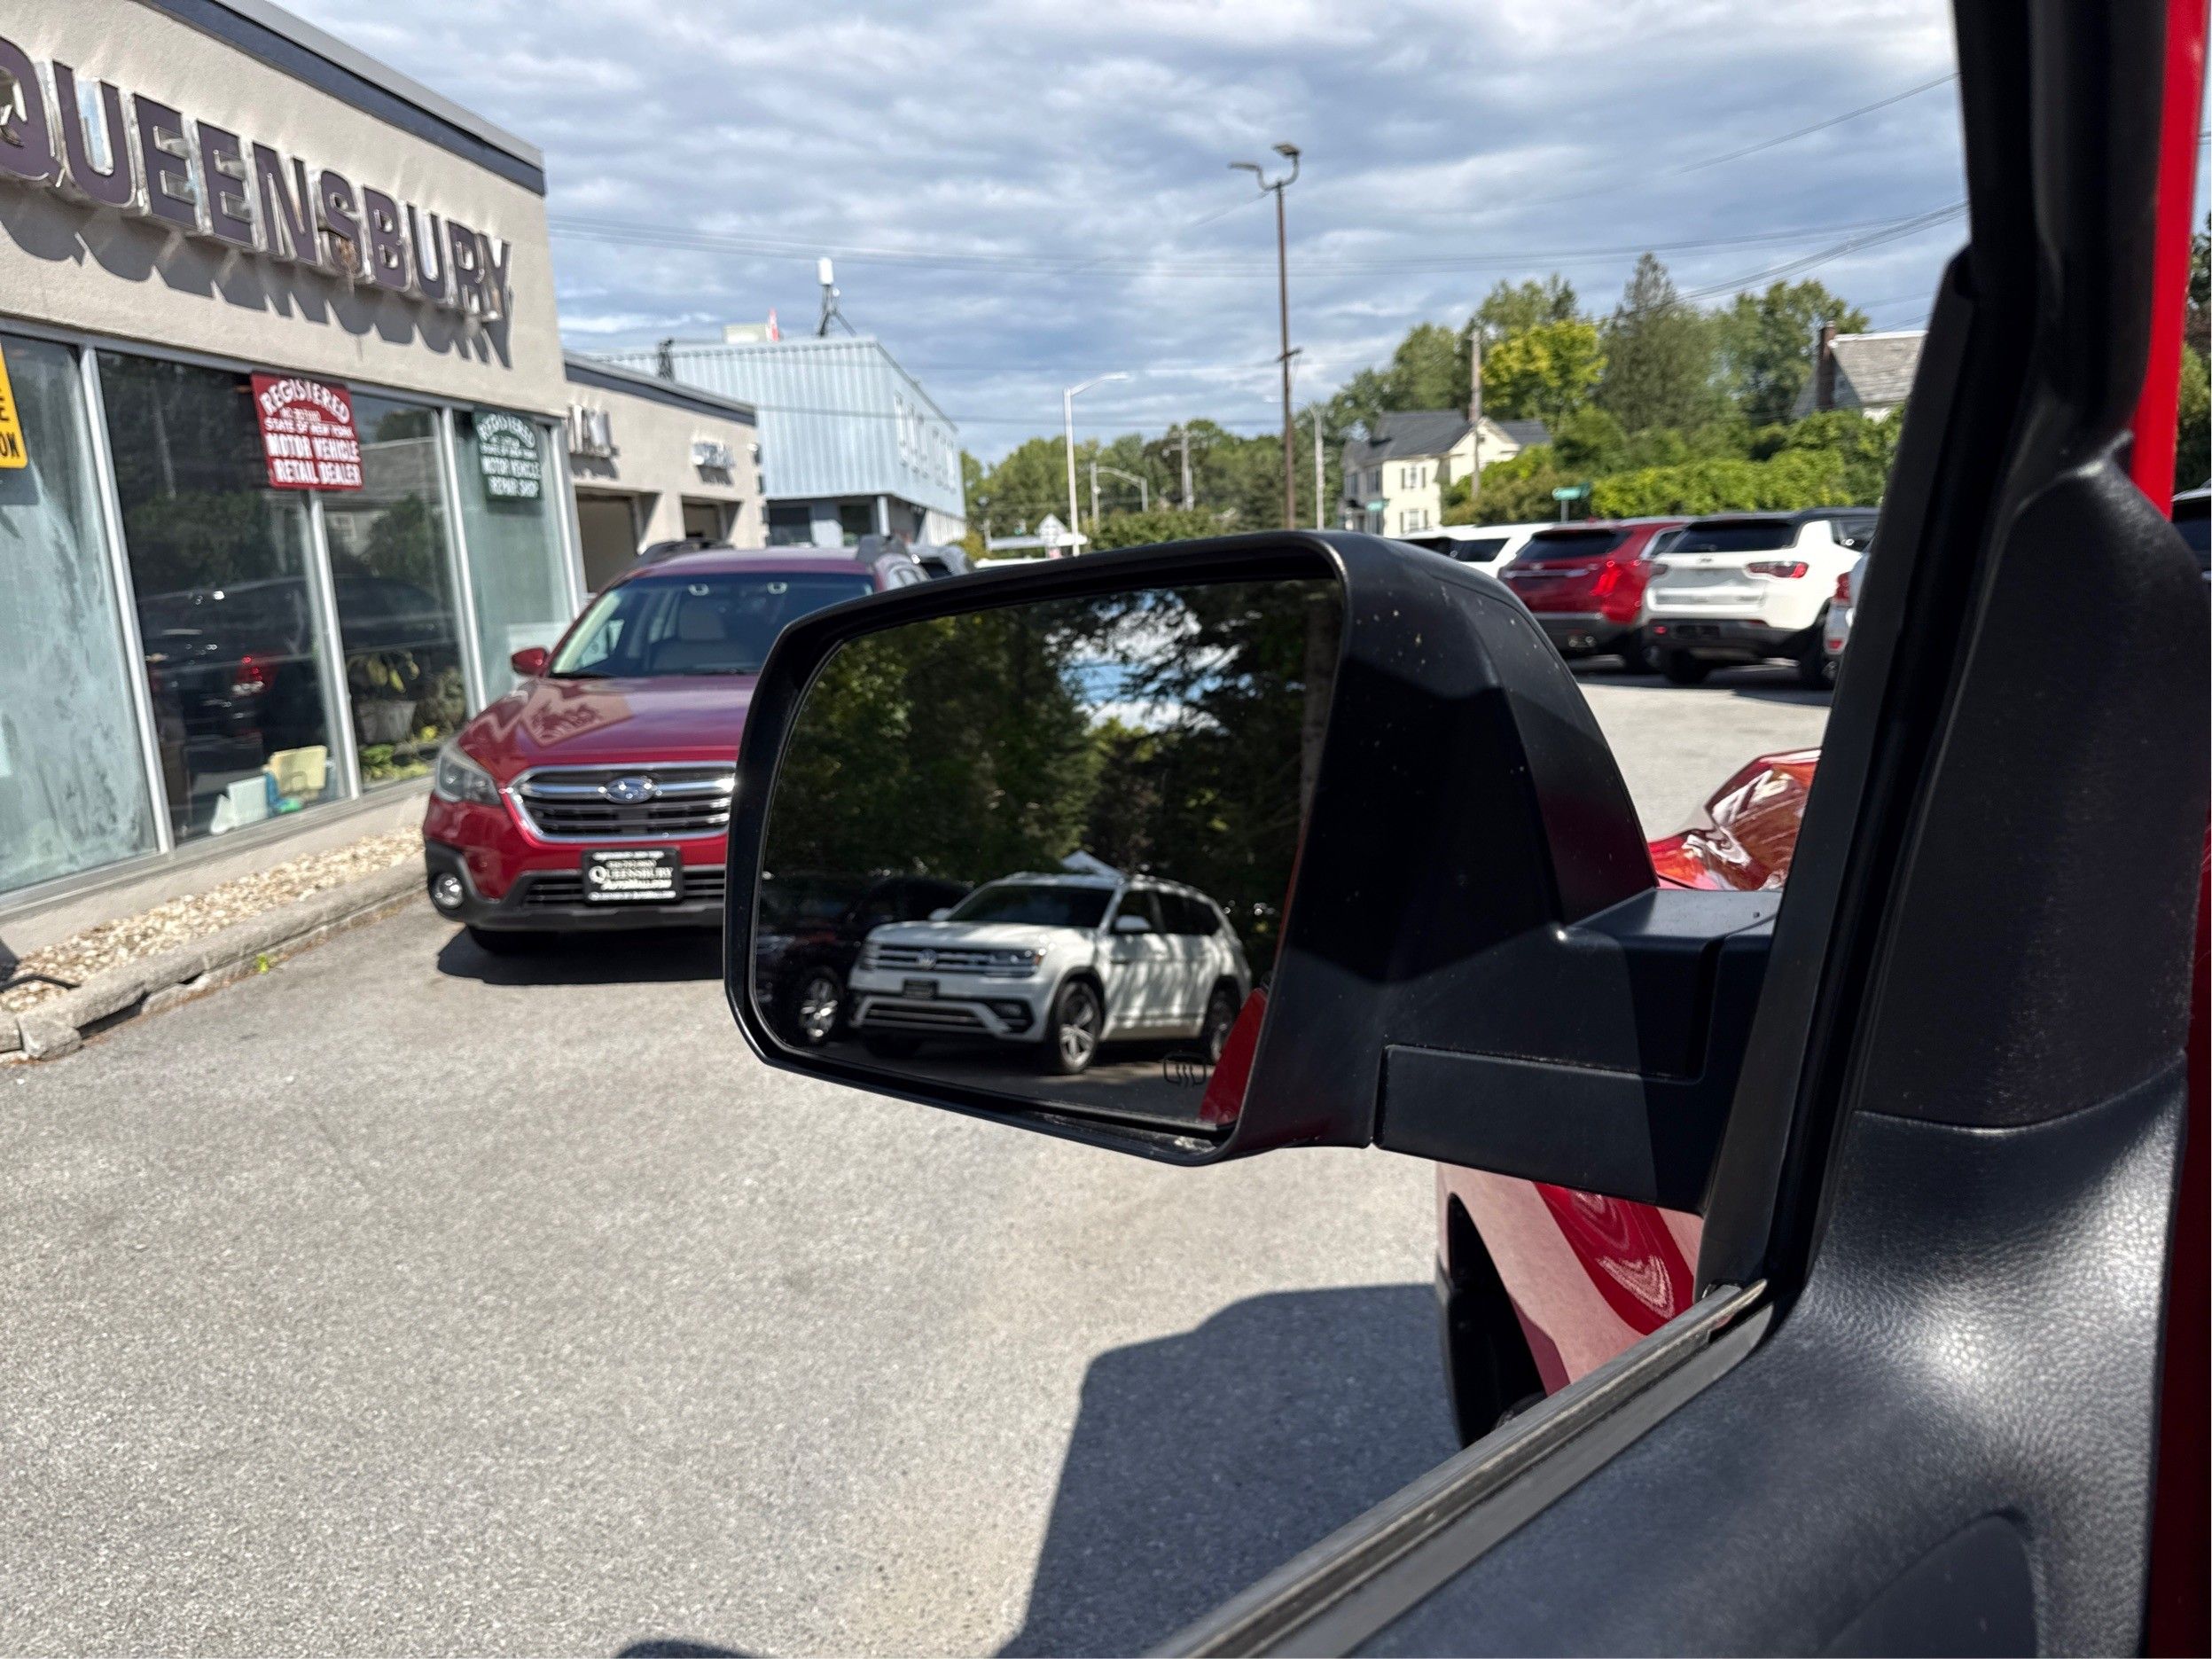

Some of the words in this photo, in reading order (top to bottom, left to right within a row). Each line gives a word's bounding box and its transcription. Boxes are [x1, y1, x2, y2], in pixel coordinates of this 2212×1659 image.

[259, 378, 350, 424] REGISTERED
[264, 417, 295, 434] STATE
[295, 420, 309, 434] OF
[309, 422, 330, 436] NEW
[265, 432, 314, 458] MOTOR
[311, 436, 361, 462] VEHICLE
[272, 458, 320, 483] RETAIL
[317, 462, 363, 485] DEALER
